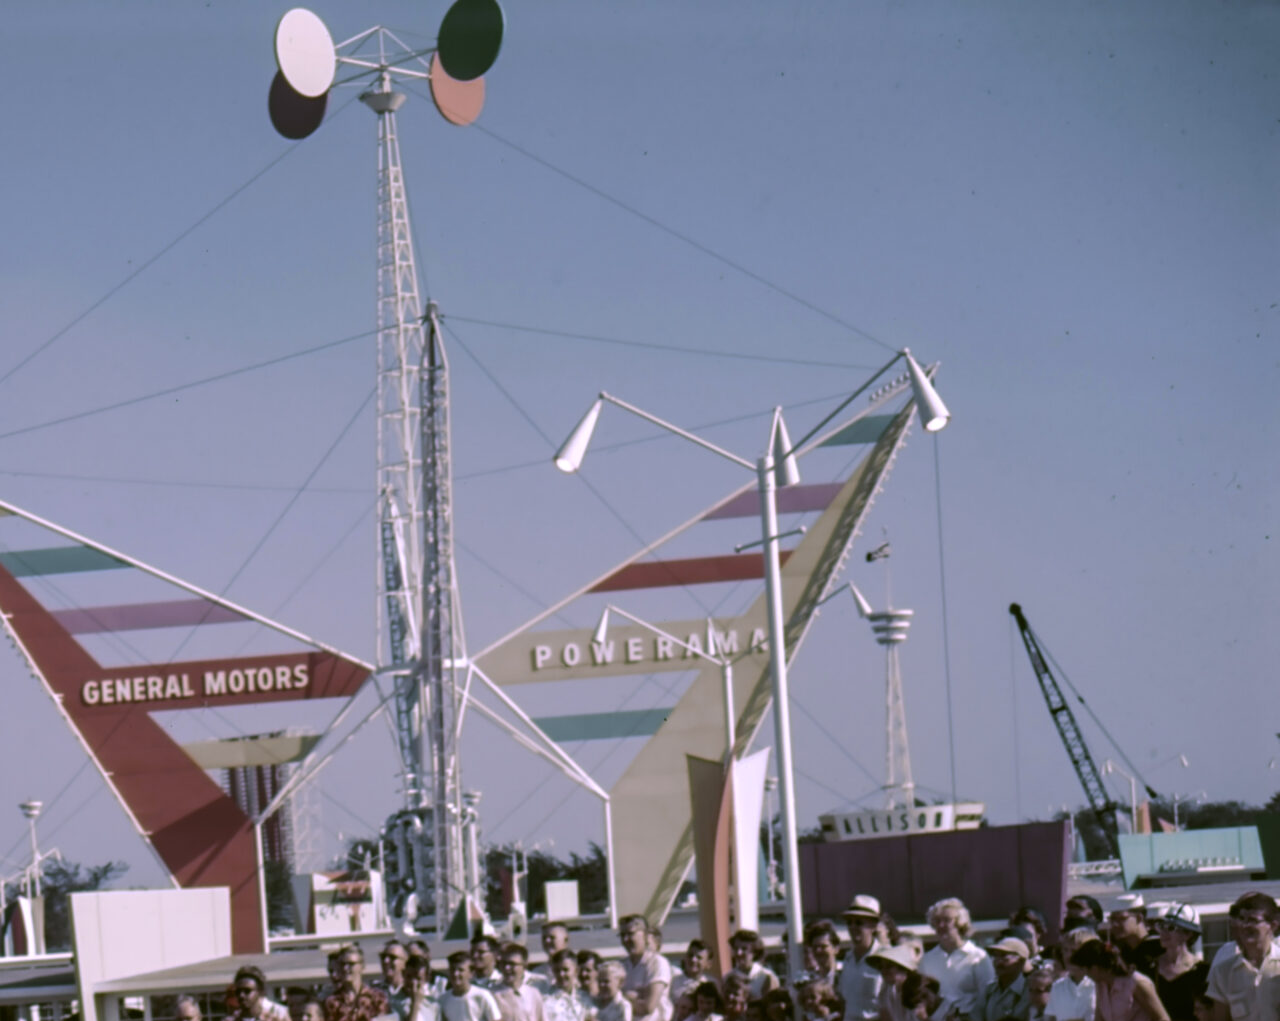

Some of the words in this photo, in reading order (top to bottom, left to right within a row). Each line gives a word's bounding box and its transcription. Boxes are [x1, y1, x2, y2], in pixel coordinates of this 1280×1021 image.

[534, 627, 769, 670] POWERAMA
[83, 673, 195, 704] GENERAL
[204, 664, 309, 695] MOTORS
[842, 811, 943, 834] ALLISON
